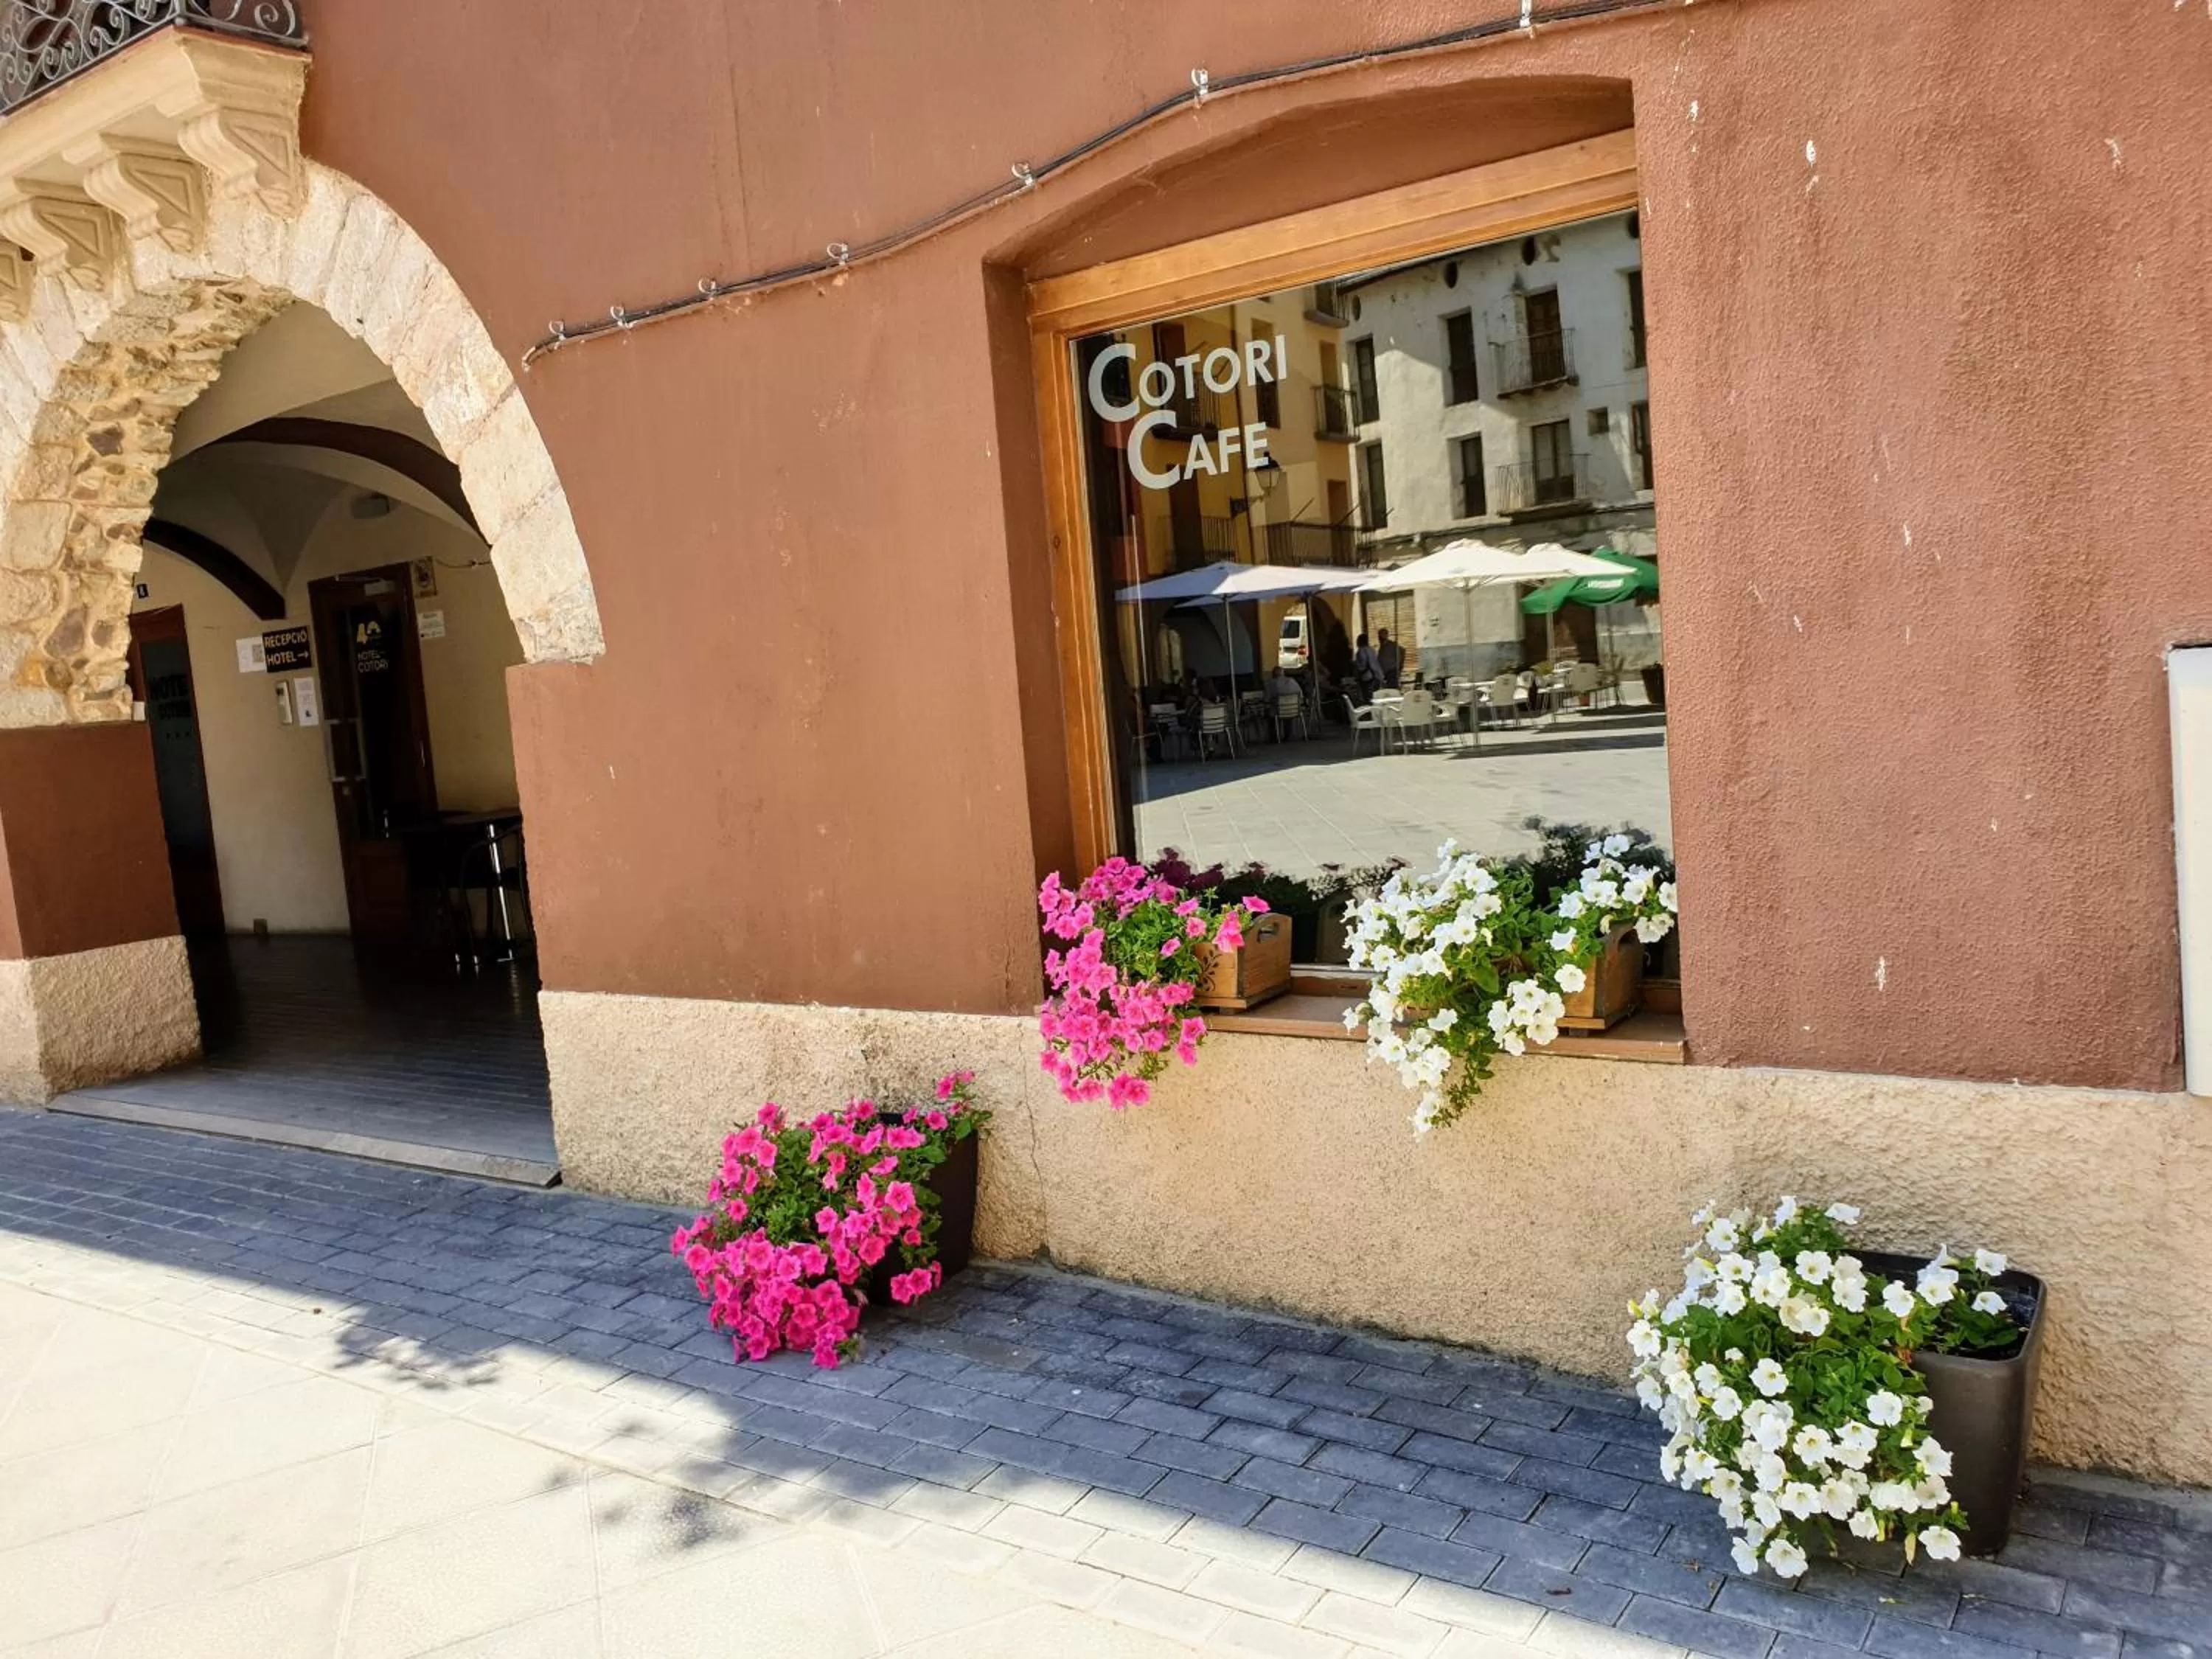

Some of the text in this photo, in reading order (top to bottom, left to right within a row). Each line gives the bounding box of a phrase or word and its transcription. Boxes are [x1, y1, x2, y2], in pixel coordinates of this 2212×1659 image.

[1088, 335, 1287, 422] COTORI
[1128, 410, 1269, 490] CAFE
[266, 650, 298, 667] HOTEL
